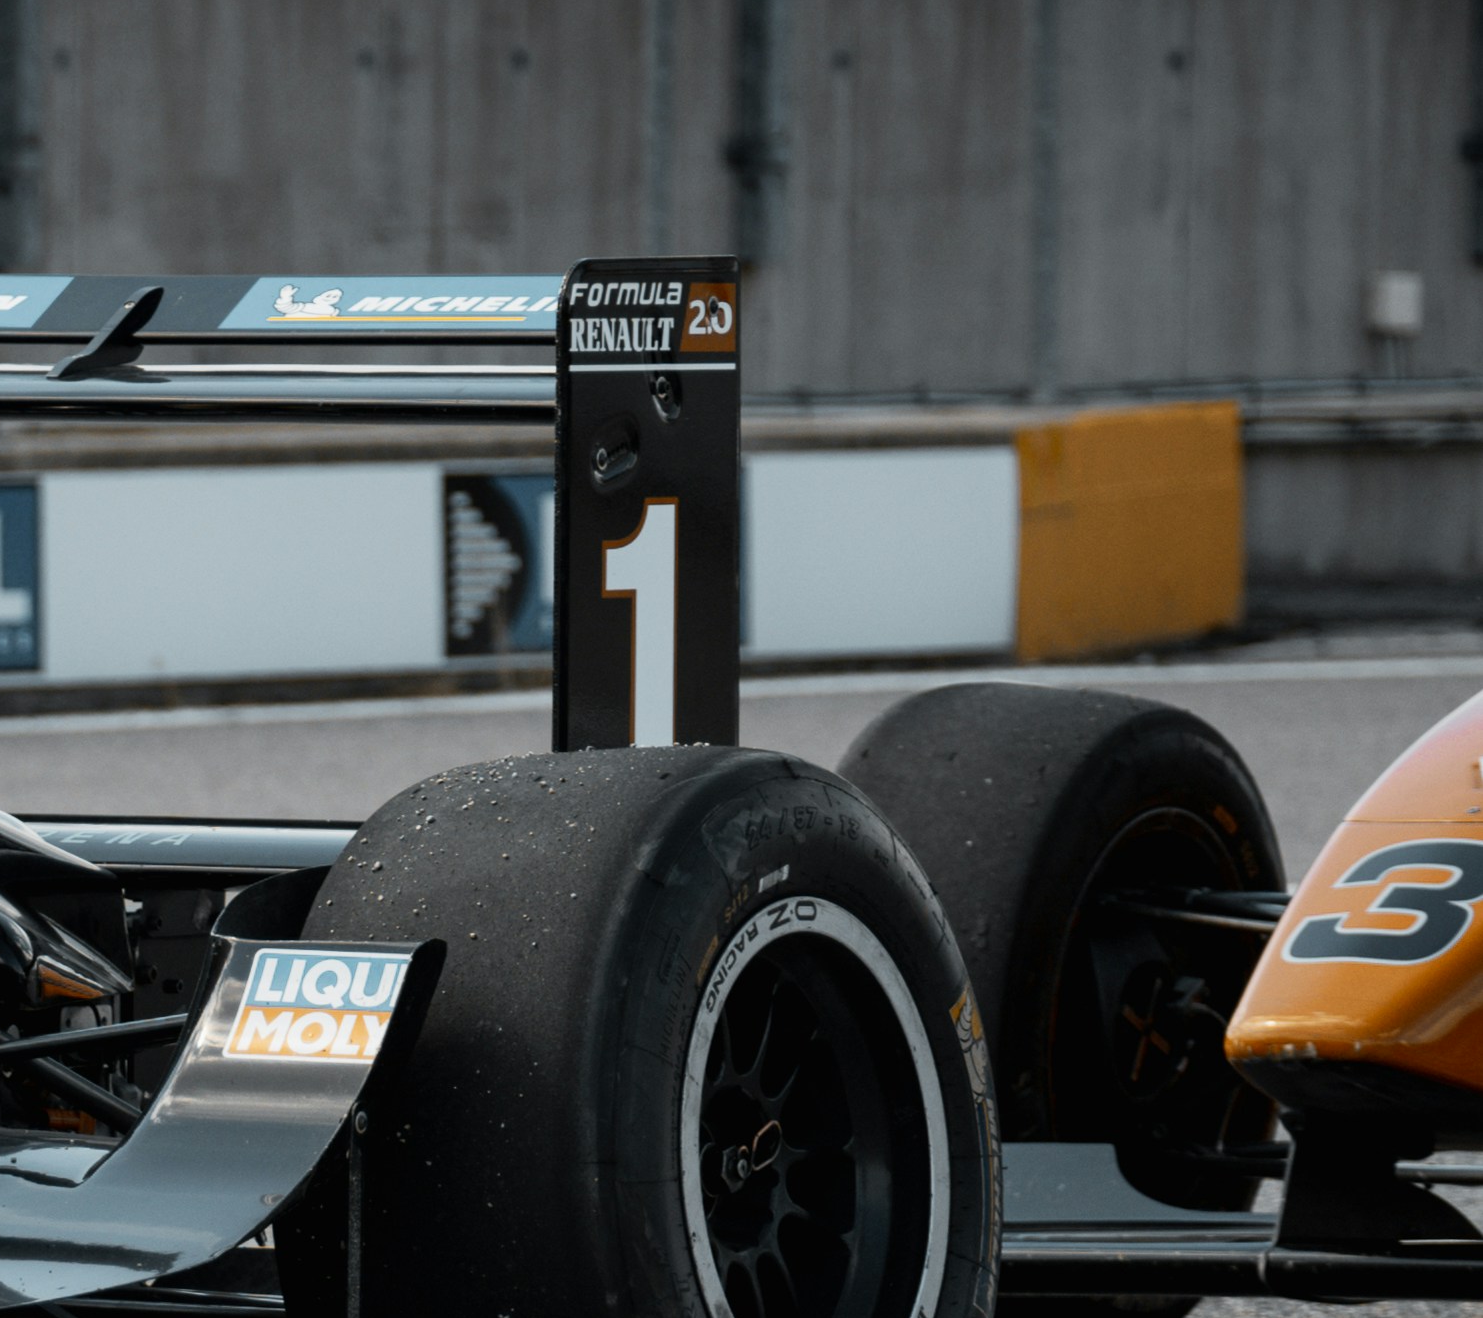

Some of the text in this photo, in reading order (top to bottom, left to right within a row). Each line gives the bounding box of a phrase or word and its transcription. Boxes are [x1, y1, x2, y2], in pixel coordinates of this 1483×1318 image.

[568, 317, 674, 353] RENAULT
[688, 299, 733, 336] 2.0
[602, 497, 679, 747] 1
[40, 831, 194, 847] ENA
[1280, 837, 1483, 967] 3
[705, 921, 760, 1014] RACING
[236, 1009, 390, 1057] MOLY
